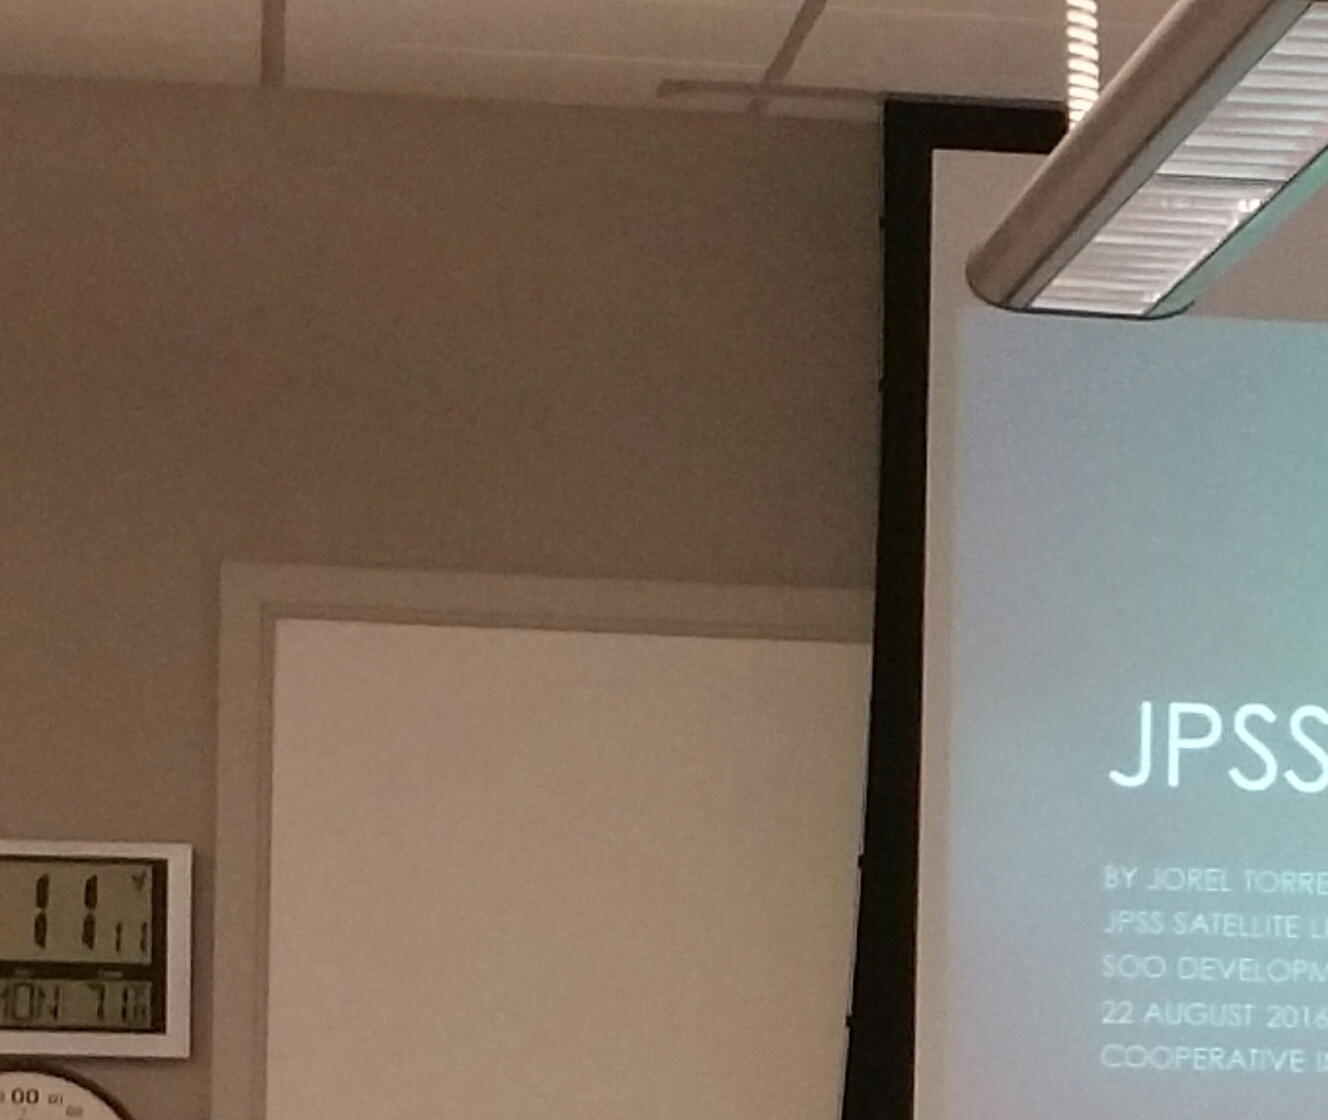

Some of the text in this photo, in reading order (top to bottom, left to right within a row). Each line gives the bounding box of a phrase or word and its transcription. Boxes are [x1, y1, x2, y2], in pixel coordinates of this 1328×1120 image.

[1104, 865, 1139, 890] BY
[1148, 868, 1232, 893] JOREL
[1104, 911, 1165, 936] JPSS
[1173, 914, 1300, 939] SATELLITE
[1101, 954, 1167, 979] SOO
[1100, 1001, 1134, 1025] 22
[1143, 1003, 1253, 1027] AUGUST
[1100, 1044, 1306, 1073] COOPERATIVE
[11, 1087, 40, 1105] 00
